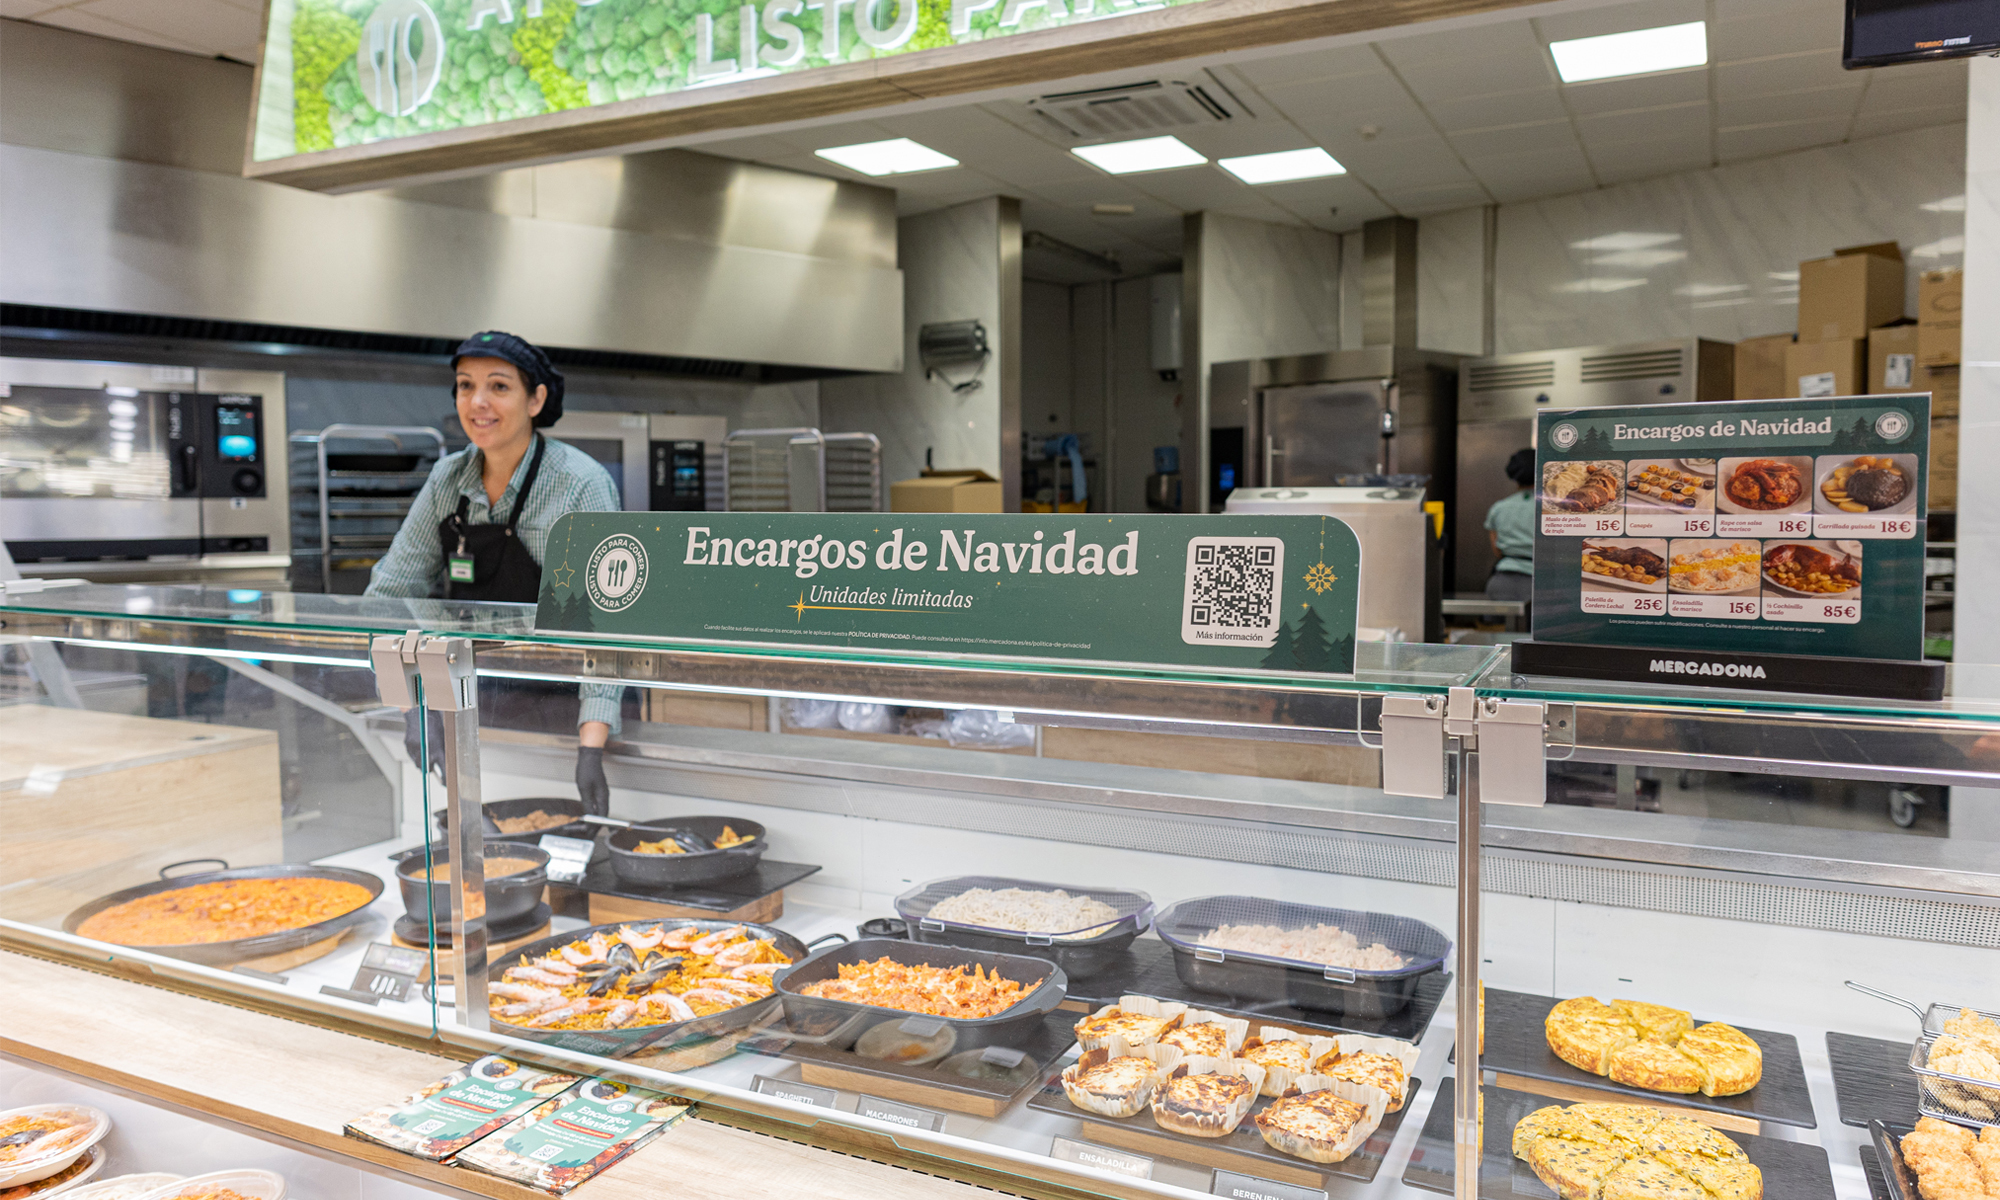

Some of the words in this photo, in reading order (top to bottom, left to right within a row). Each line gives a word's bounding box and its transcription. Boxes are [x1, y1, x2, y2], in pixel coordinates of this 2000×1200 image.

[694, 0, 917, 78] LISTO
[1613, 423, 1705, 442] Encargos
[1709, 420, 1735, 437] de
[1740, 416, 1832, 437] Navidad
[1596, 520, 1620, 531] 15€
[1684, 520, 1710, 532] 15€
[1779, 520, 1807, 532] 18€
[1881, 521, 1911, 533] 18€
[591, 545, 608, 569] LISTO
[608, 538, 628, 549] PARA
[628, 542, 645, 570] COMER
[683, 526, 867, 579] Encargos
[875, 528, 928, 571] de
[936, 529, 1139, 576] Navidad
[589, 575, 601, 600] LISTO
[599, 597, 620, 608] PARA
[621, 577, 644, 605] COMER
[810, 585, 887, 605] Unidades
[891, 588, 973, 608] limitadas
[1634, 598, 1663, 610] 25€
[1729, 602, 1756, 614] 15€
[1823, 605, 1856, 618] 85€
[1196, 630, 1214, 640] Más
[1214, 631, 1264, 642] información
[1649, 659, 1767, 679] MERCADONA
[449, 1089, 464, 1100] de
[463, 1091, 513, 1109] Navidad
[465, 1084, 516, 1102] Encargos
[775, 1091, 814, 1105] SPAGHETTI
[561, 1110, 578, 1121] de
[576, 1115, 630, 1134] Navidad
[577, 1105, 632, 1126] Encargos
[866, 1109, 919, 1127] MACARRONES
[1079, 1152, 1138, 1172] ENSALADILLA
